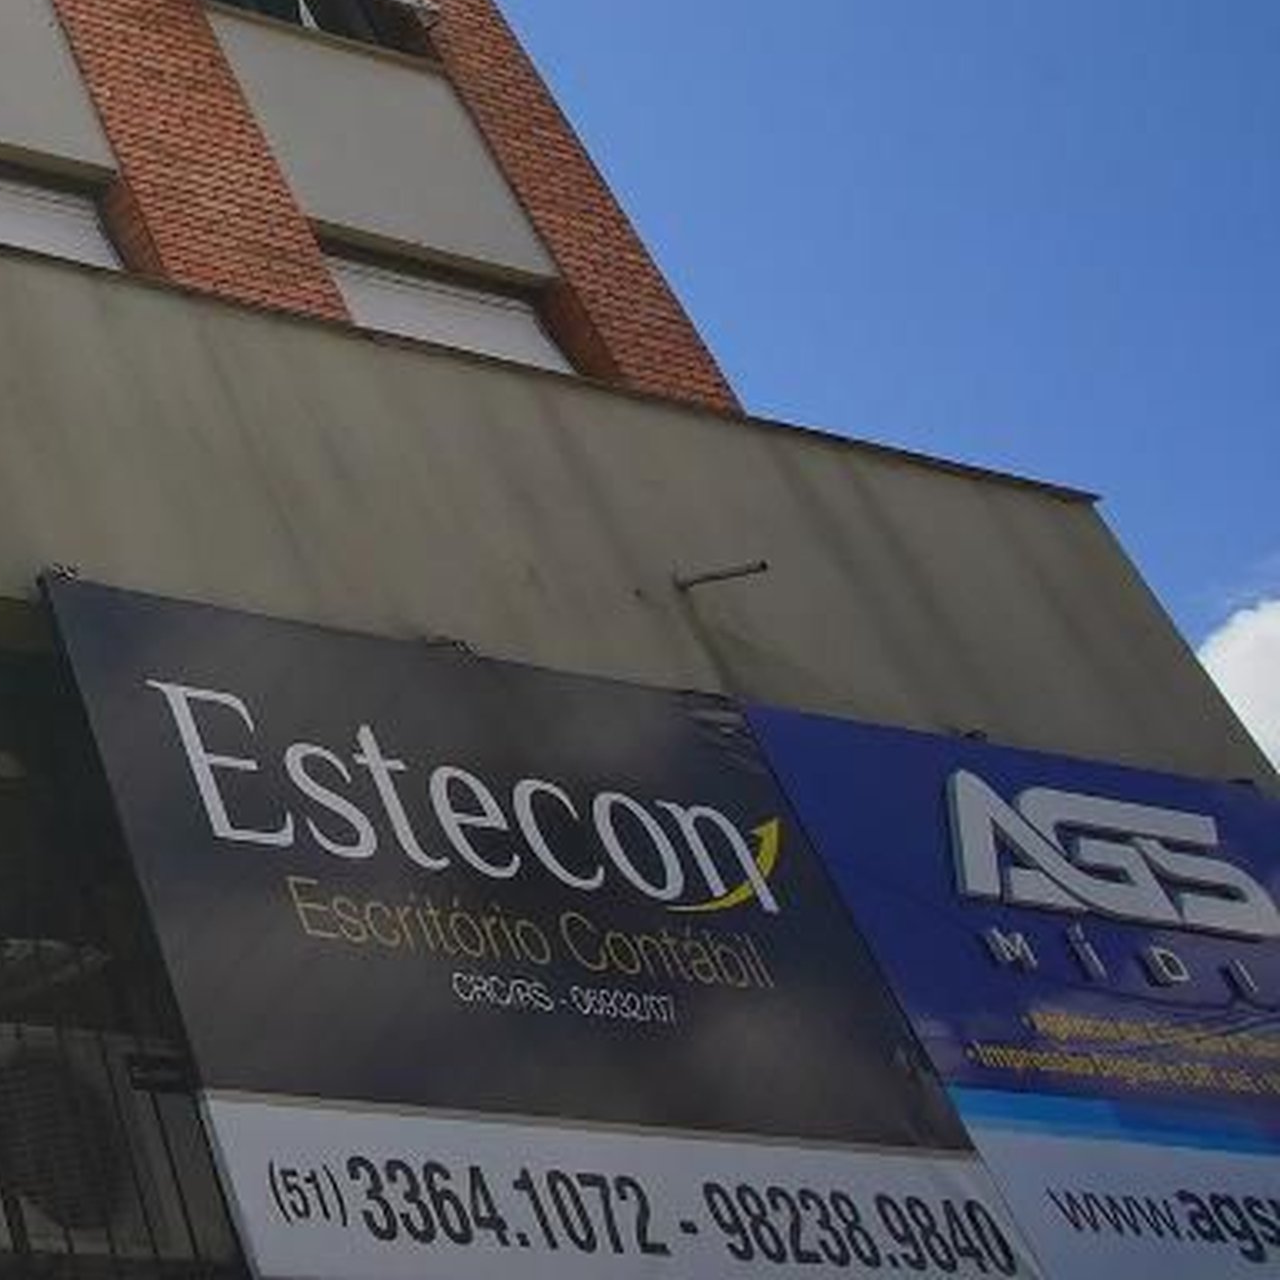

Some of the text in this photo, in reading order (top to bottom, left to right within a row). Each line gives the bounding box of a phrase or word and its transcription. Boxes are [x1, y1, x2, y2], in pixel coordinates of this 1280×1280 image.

[145, 679, 779, 915] Estecon
[286, 875, 776, 989] Escritório Contábil
[268, 1158, 348, 1228] (51)
[346, 1155, 672, 1256] 3364.1072
[702, 1181, 1018, 1276] 98238.9840
[1046, 1187, 1280, 1263] www.ags
